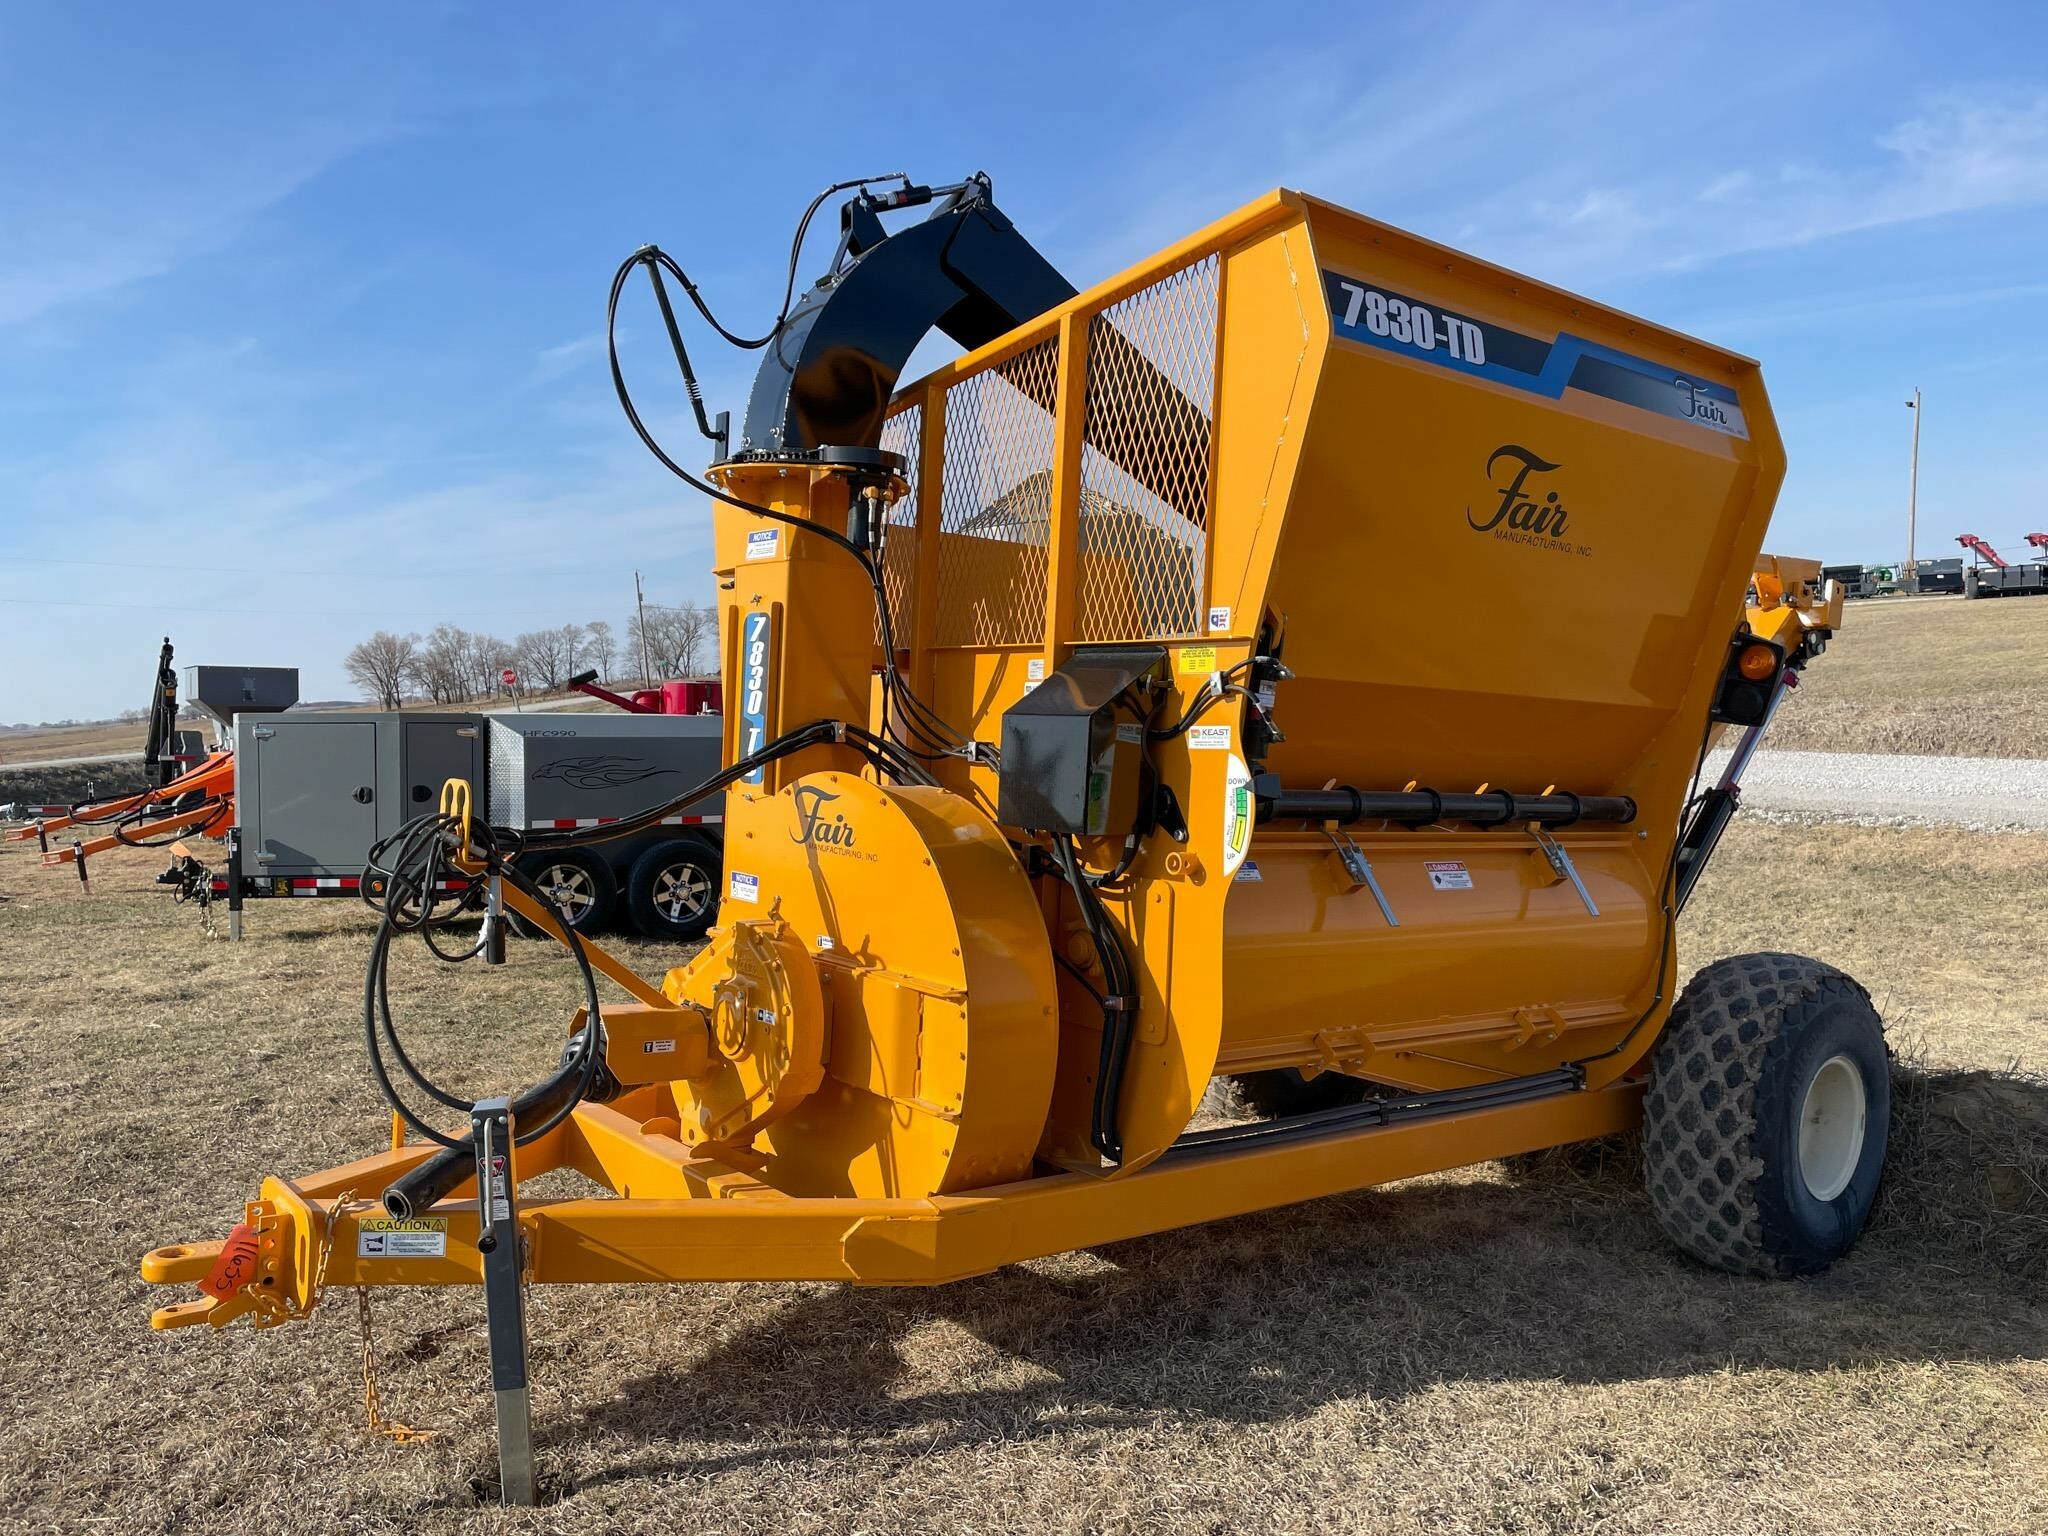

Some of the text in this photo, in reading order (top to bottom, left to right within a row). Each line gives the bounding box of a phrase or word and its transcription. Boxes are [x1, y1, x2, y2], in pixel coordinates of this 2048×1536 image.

[1340, 281, 1486, 366] 7830-TD
[1674, 375, 1727, 424] Fair
[1467, 444, 1569, 537] Fair
[752, 531, 772, 542] NOTICE
[1493, 529, 1572, 555] MANUFACTURING,
[748, 616, 767, 714] 7830
[1201, 728, 1229, 736] KEAST
[789, 785, 856, 847] Fair
[735, 873, 753, 886] NOTICE
[1432, 863, 1459, 871] DANGER
[376, 1220, 431, 1231] CAUTION
